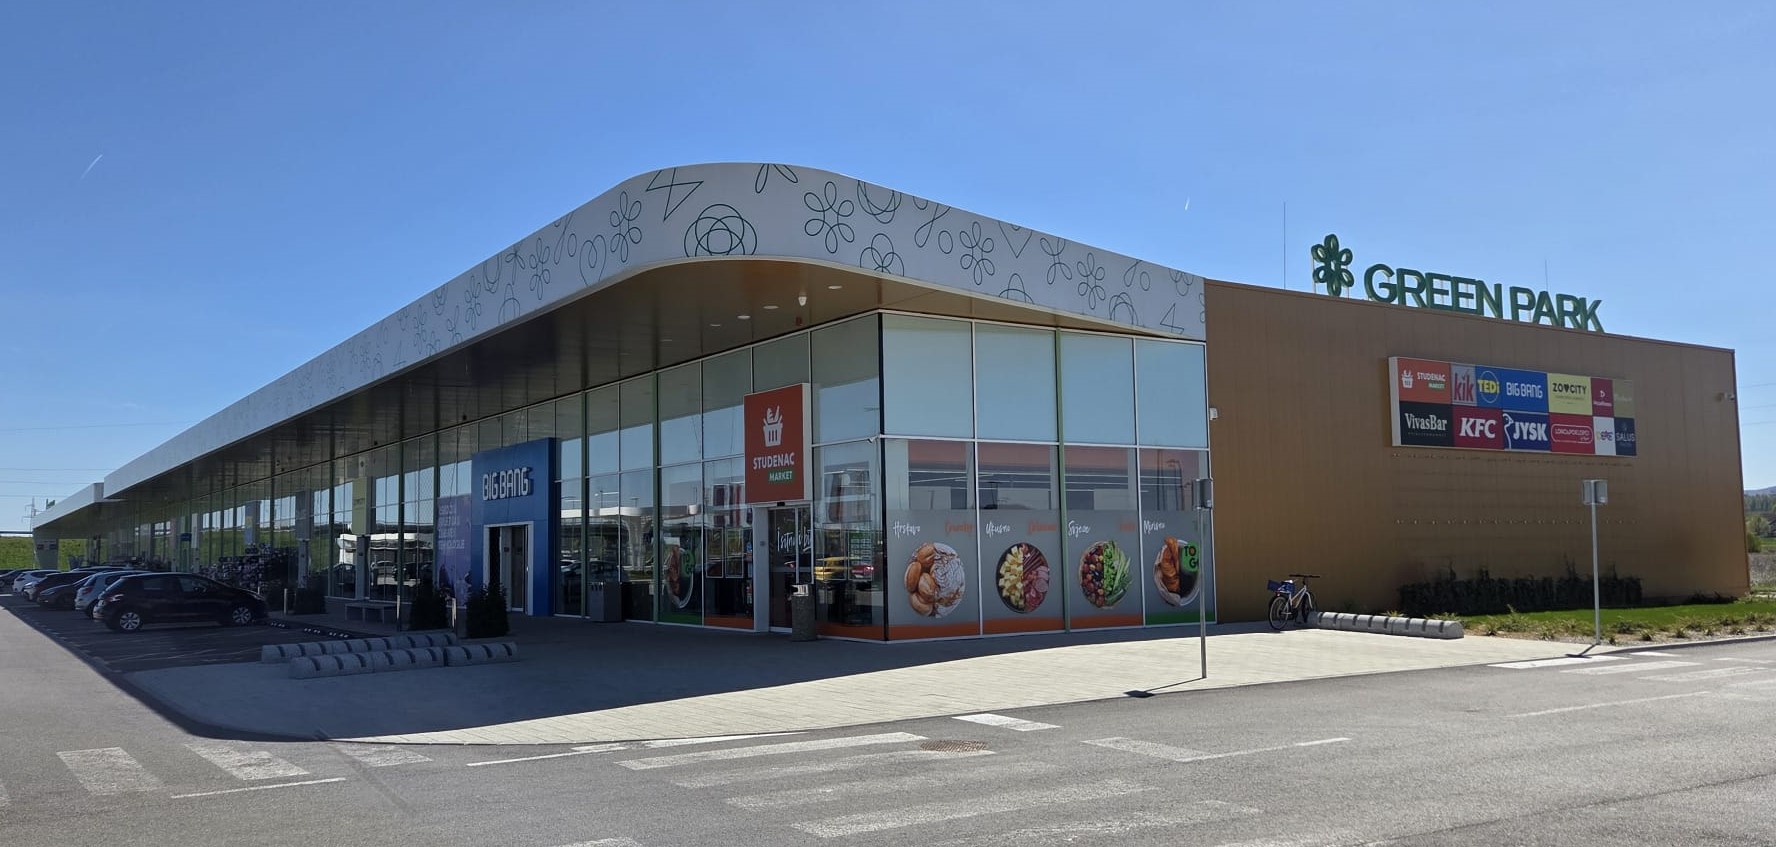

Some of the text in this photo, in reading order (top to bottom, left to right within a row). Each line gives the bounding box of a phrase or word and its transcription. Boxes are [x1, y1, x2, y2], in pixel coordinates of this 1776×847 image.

[1364, 263, 1605, 333] GREEN PARK
[1417, 371, 1446, 382] STUDENAC
[1506, 381, 1543, 399] BIG BANG
[1404, 412, 1448, 431] VivasBar
[1459, 417, 1497, 438] KFC
[1513, 421, 1548, 441] JYSK
[1615, 431, 1636, 442] SALUS
[753, 451, 795, 470] STUDENAC
[482, 466, 529, 501] BIG BANG
[769, 470, 793, 482] MARKET
[1184, 545, 1197, 557] TO
